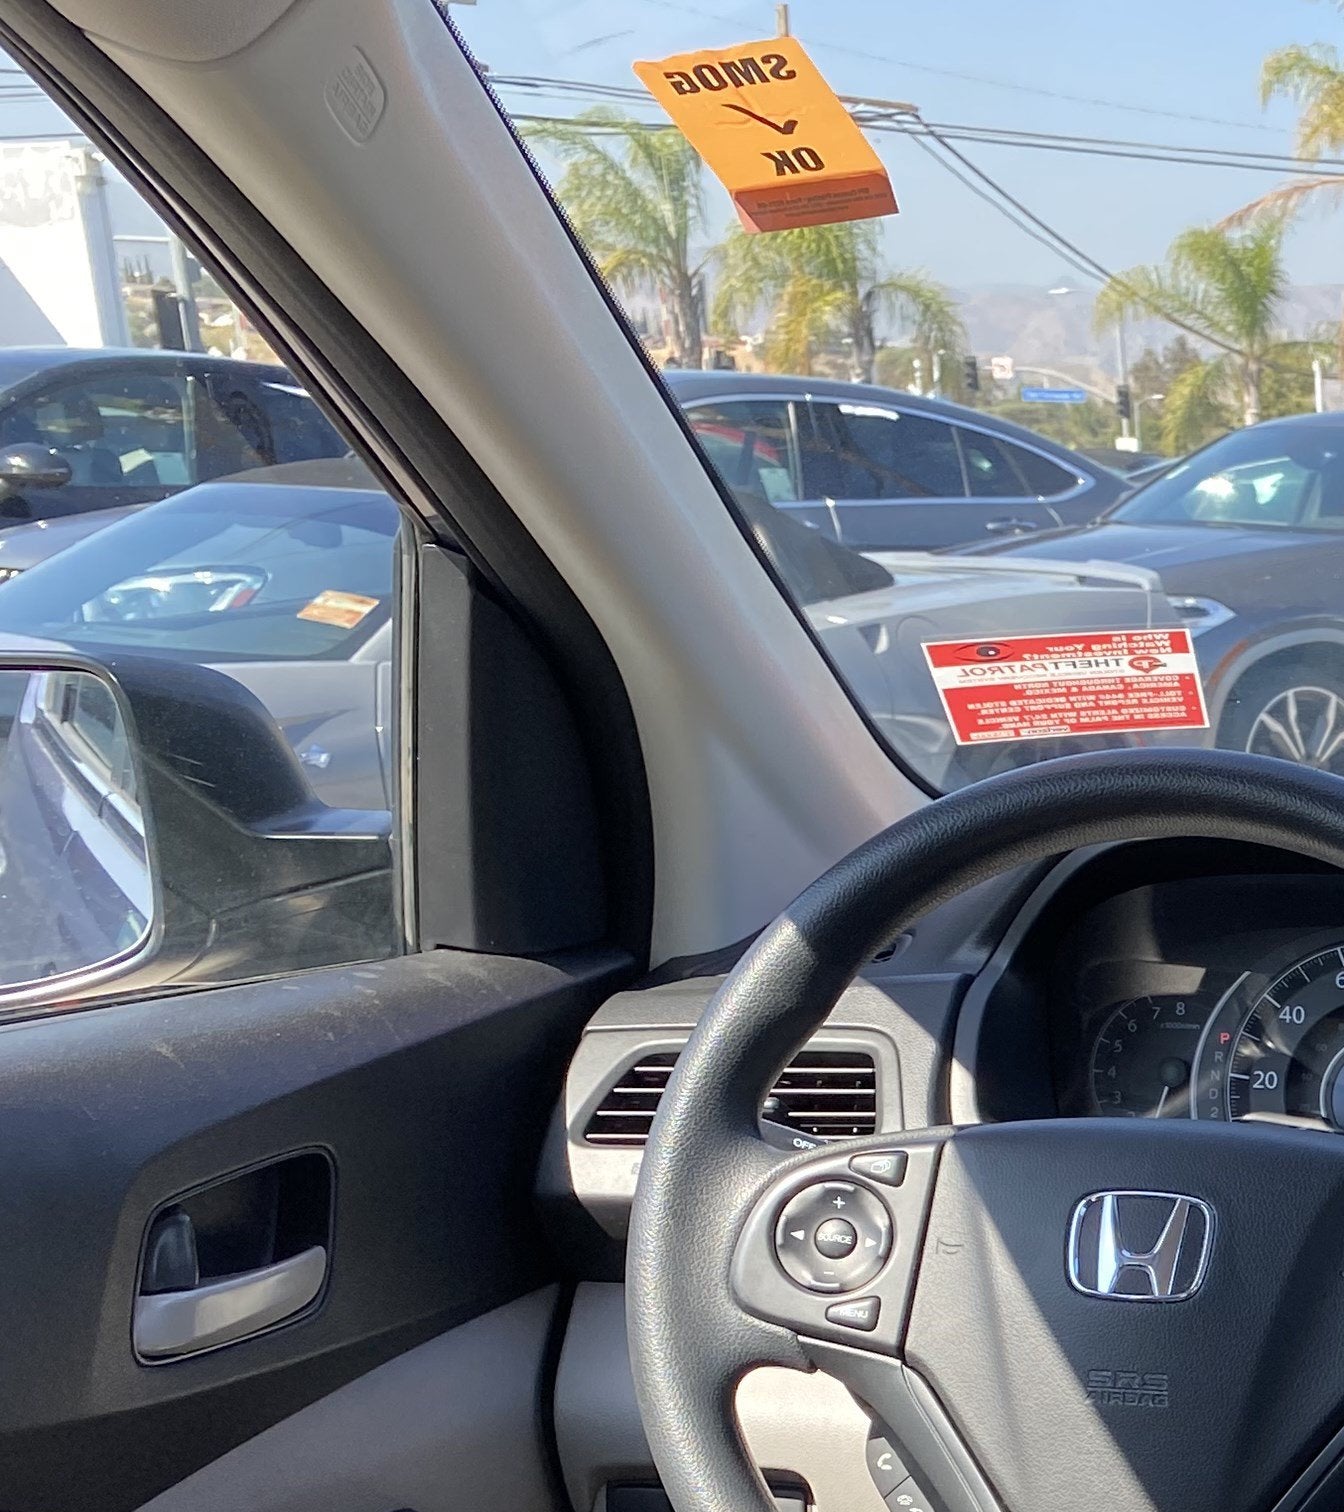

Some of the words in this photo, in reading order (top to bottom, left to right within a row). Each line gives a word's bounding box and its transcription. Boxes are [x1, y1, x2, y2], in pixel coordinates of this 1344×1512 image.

[1152, 1007, 1161, 1020] 7
[1176, 1002, 1185, 1015] 8
[1278, 1005, 1305, 1024] 40
[1127, 1019, 1137, 1032] 6
[1219, 1032, 1230, 1044] P
[1114, 1040, 1123, 1053] 5
[1215, 1052, 1224, 1063] R
[1107, 1065, 1116, 1077] 4
[1211, 1070, 1221, 1081] N
[1252, 1071, 1278, 1090] 20
[1112, 1091, 1121, 1104] 3
[1209, 1089, 1219, 1100] D
[1210, 1107, 1219, 1119] 2
[817, 1232, 853, 1244] SOURCE
[839, 1306, 869, 1319] MENU
[1087, 1368, 1168, 1392] SRS
[1085, 1391, 1168, 1408] AIRBAG
